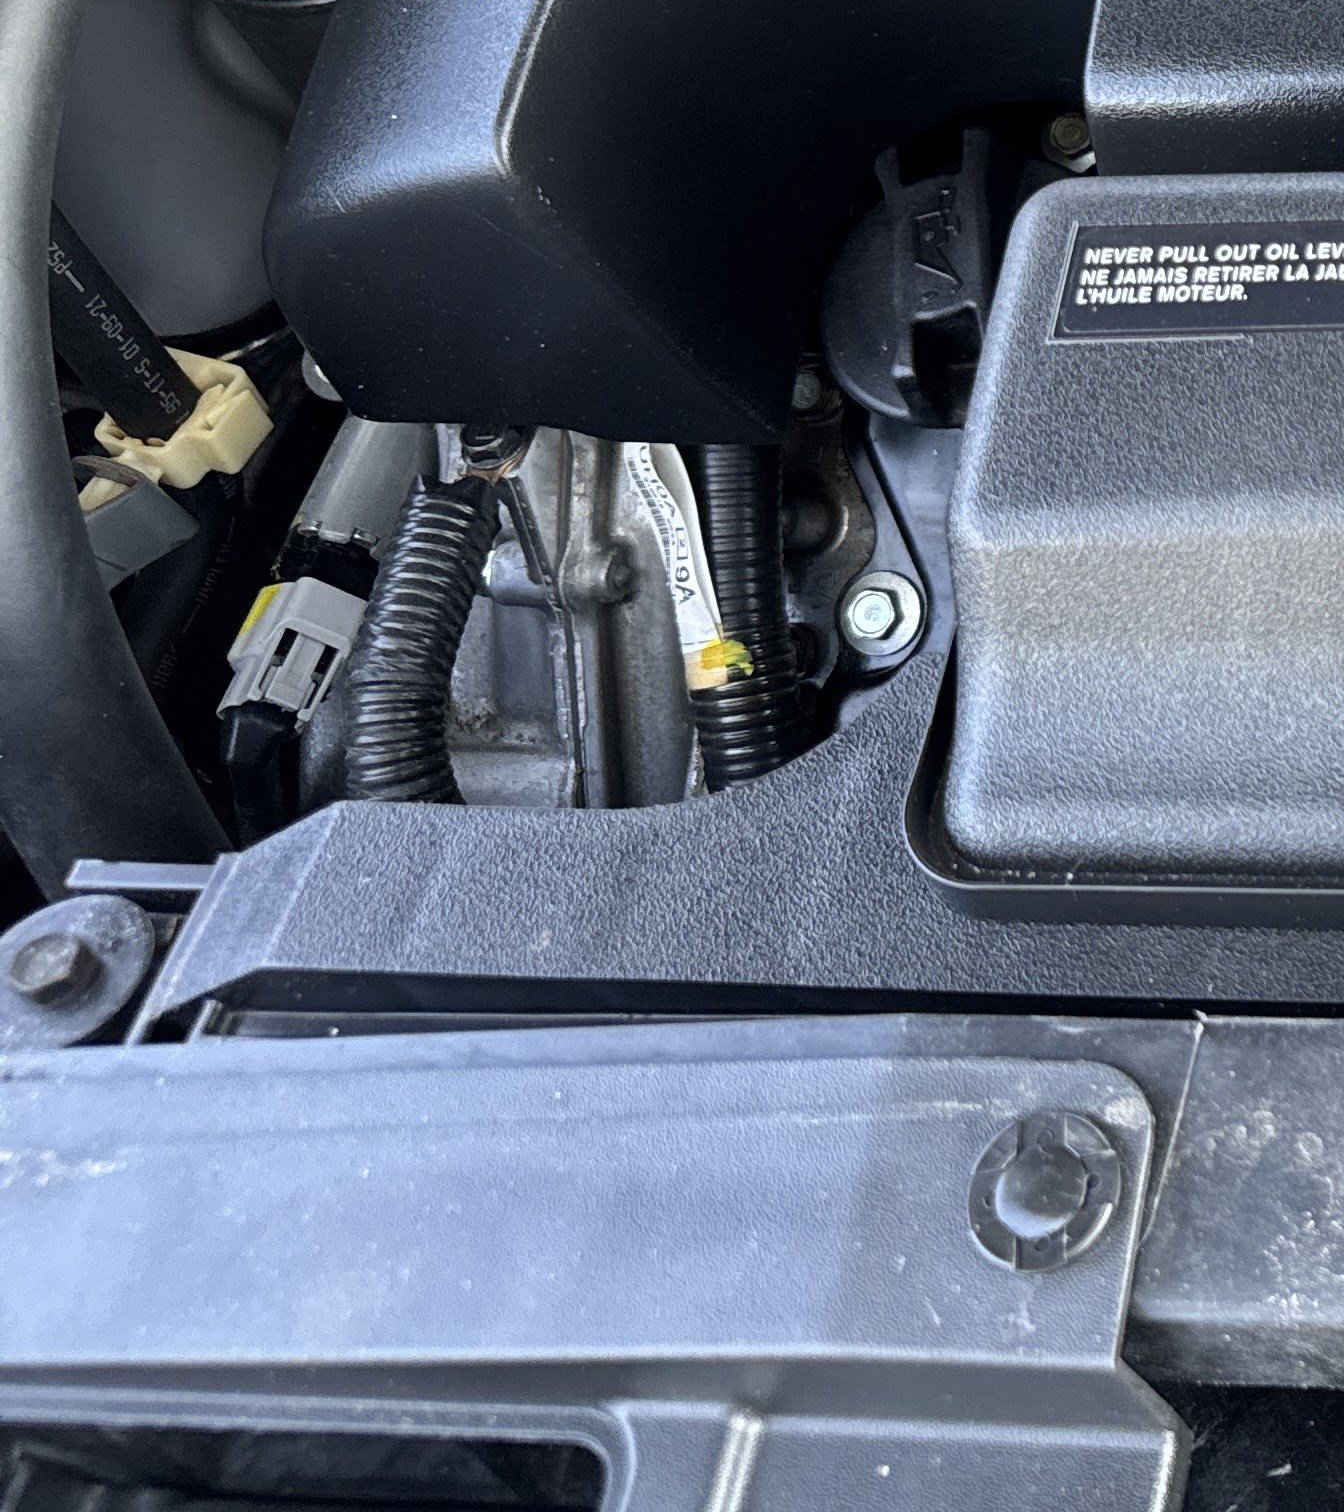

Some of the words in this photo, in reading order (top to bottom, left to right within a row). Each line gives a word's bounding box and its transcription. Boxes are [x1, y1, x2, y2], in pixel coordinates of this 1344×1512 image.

[1084, 247, 1154, 265] NEVER
[1158, 245, 1209, 264] PULL
[1215, 243, 1260, 262] OUT
[1266, 242, 1300, 261] OIL
[1080, 268, 1110, 286] NE
[1113, 267, 1188, 286] JAMAIS
[1194, 264, 1279, 284] RETIRER
[1285, 263, 1310, 282] LA
[1076, 287, 1152, 306] L'HUILE
[1156, 284, 1249, 304] MOTEUR.
